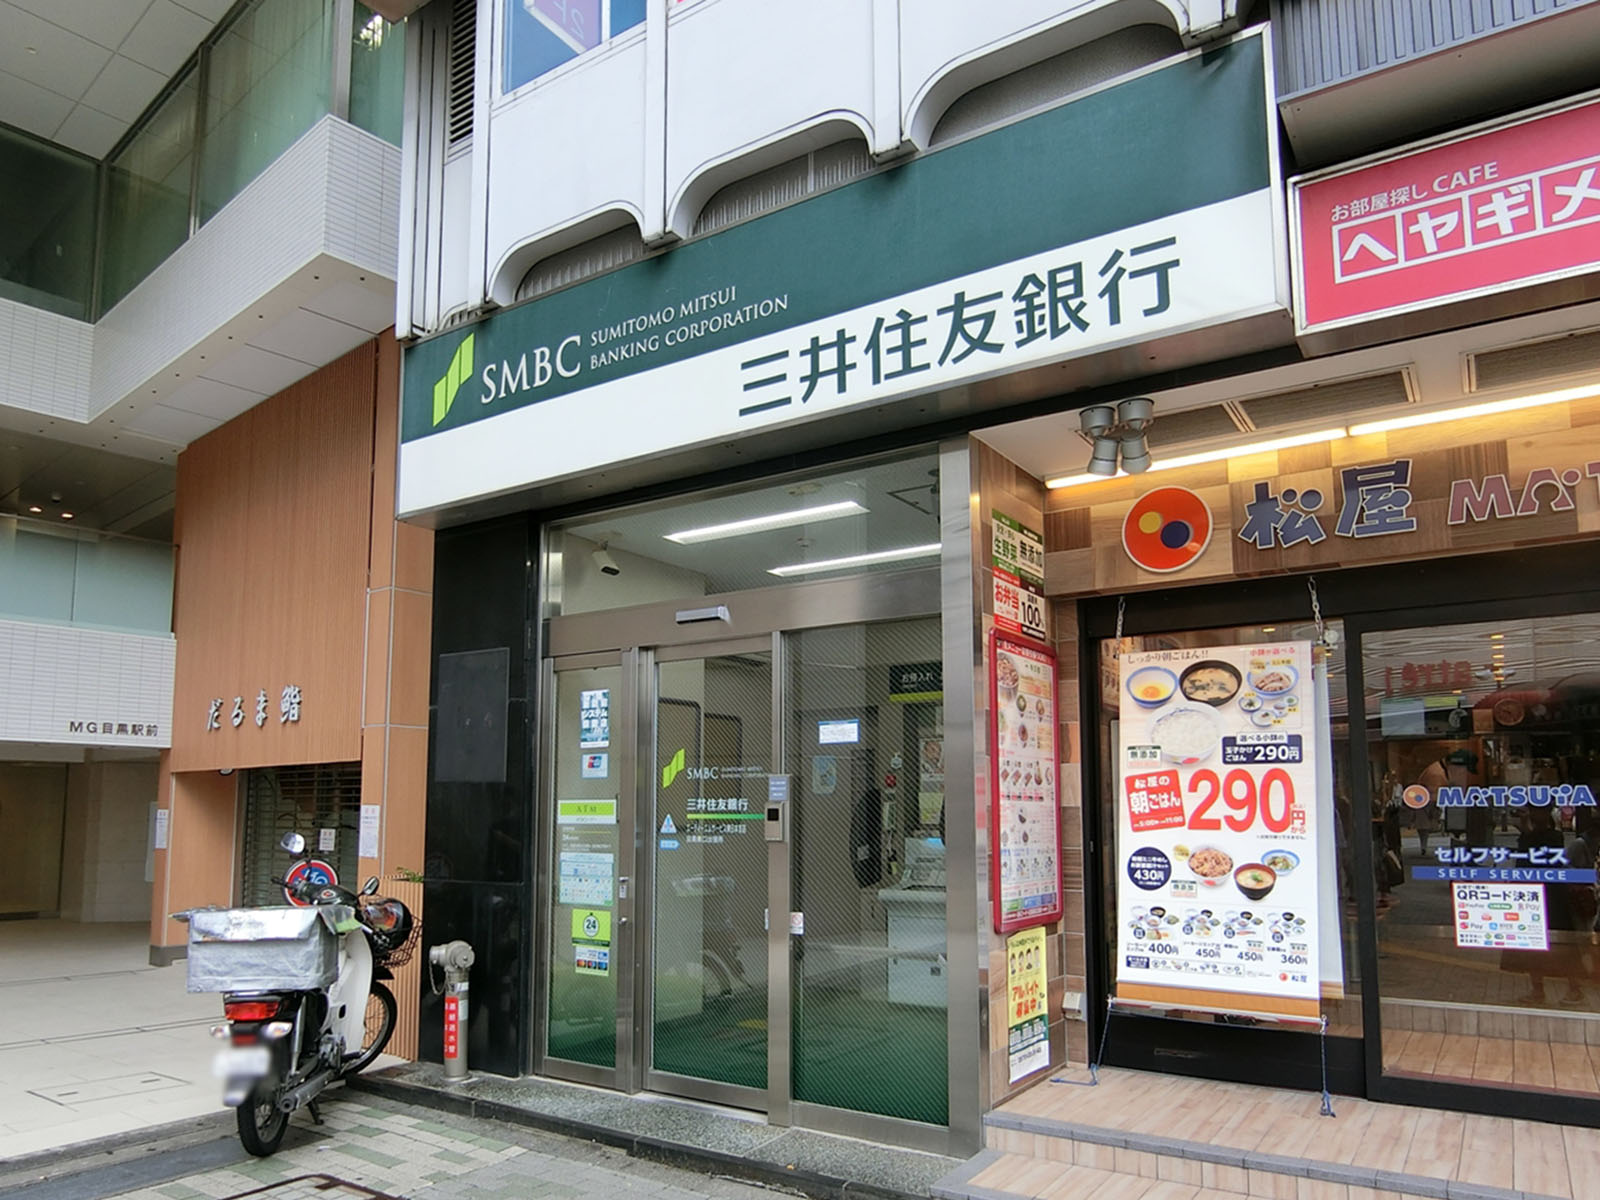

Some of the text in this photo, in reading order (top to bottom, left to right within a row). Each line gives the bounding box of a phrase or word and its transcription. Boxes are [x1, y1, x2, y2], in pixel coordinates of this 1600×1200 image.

[1331, 162, 1500, 223] お部屋探し CAFE
[1342, 167, 1600, 262] ヘヤギメ
[589, 285, 737, 347] SUMITOMO MITSUI
[589, 294, 789, 370] BANKING CORPORATION
[738, 236, 1181, 417] 三井住友銀行
[480, 335, 582, 404] SMBC
[1238, 458, 1417, 551] 松屋
[206, 684, 302, 731] だるま鮨
[686, 767, 719, 780] SMBC
[1435, 783, 1596, 808] MATSUYA
[686, 798, 748, 811] 三井住友銀行
[1129, 790, 1182, 815] 朝ごはん
[1187, 767, 1296, 834] 290
[1433, 846, 1570, 866] セルフサービス
[1437, 867, 1568, 881] SELF SERVICE
[1457, 889, 1540, 902] QRコード決済
[586, 918, 597, 930] 24
